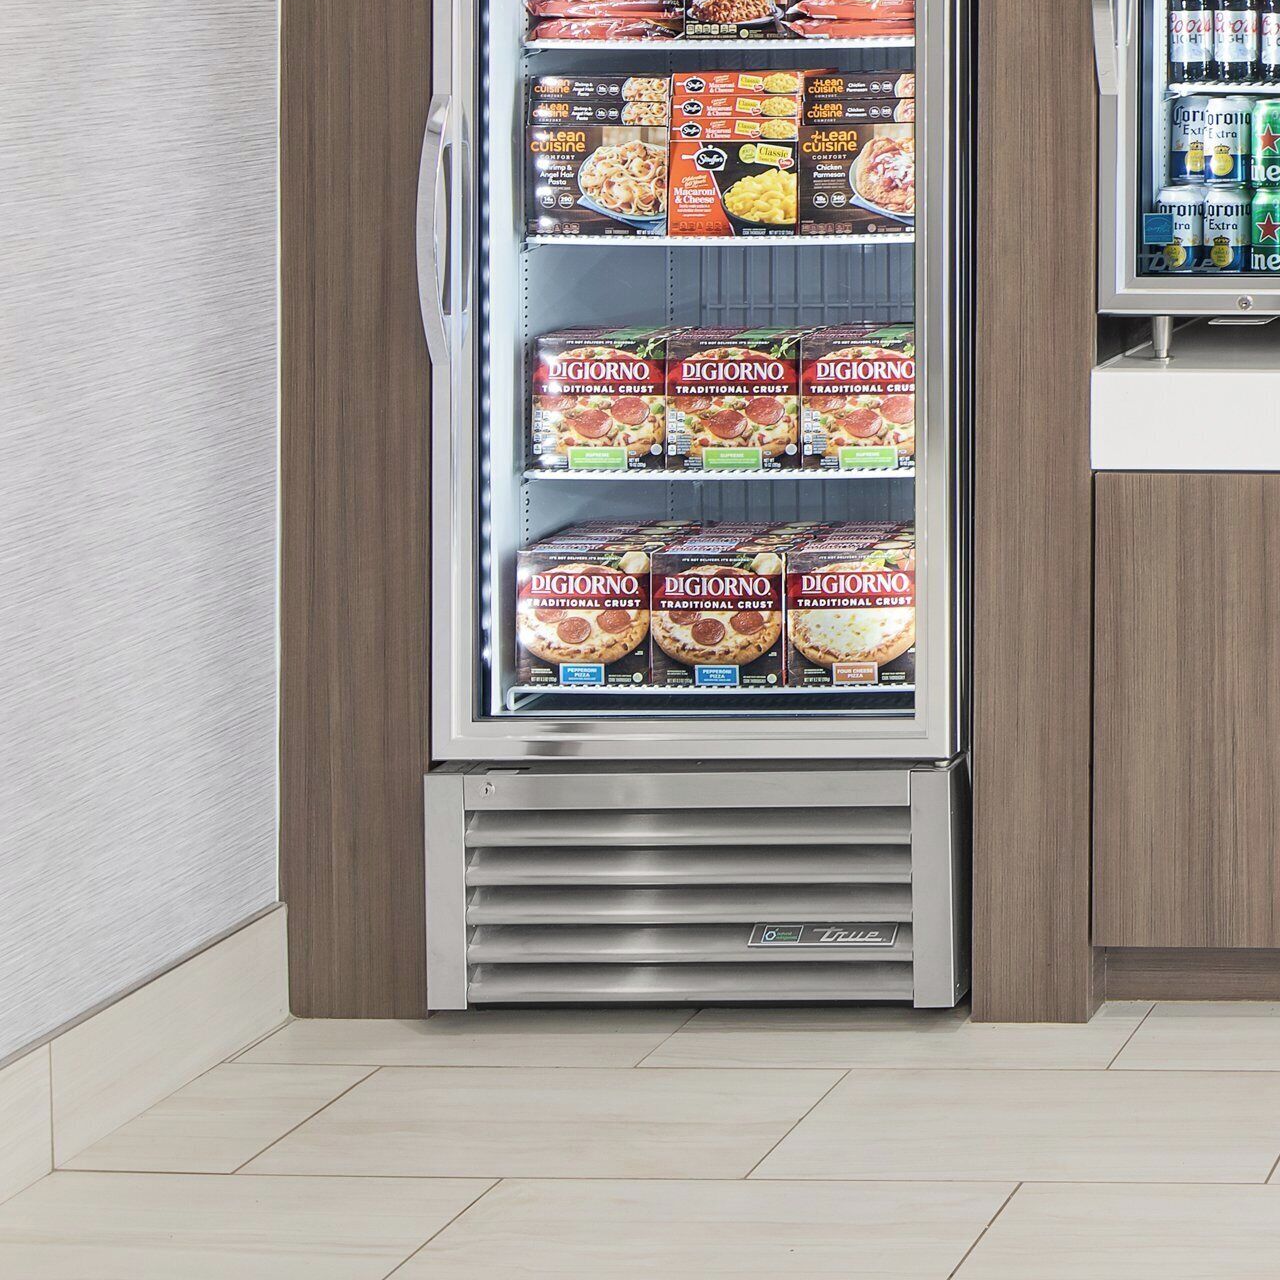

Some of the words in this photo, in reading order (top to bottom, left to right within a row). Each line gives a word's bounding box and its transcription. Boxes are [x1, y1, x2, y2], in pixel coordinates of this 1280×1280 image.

[674, 187, 715, 197] Macaroni
[683, 196, 715, 204] Cheese
[1208, 221, 1238, 231] Extra
[542, 385, 614, 393] TADITIONAL
[618, 385, 654, 393] CRUST
[676, 385, 749, 394] TRADITIONAL
[753, 385, 789, 393] CRUST
[810, 385, 883, 393] TRADITIONAL
[886, 384, 915, 393] CRUS
[527, 599, 600, 608] TRADITIONAL
[604, 599, 641, 607] CRUST
[660, 601, 733, 609] TRADITIONAL
[738, 601, 774, 609] CRUST
[797, 598, 872, 607] TRADITIONAL
[876, 597, 912, 606] CRUST
